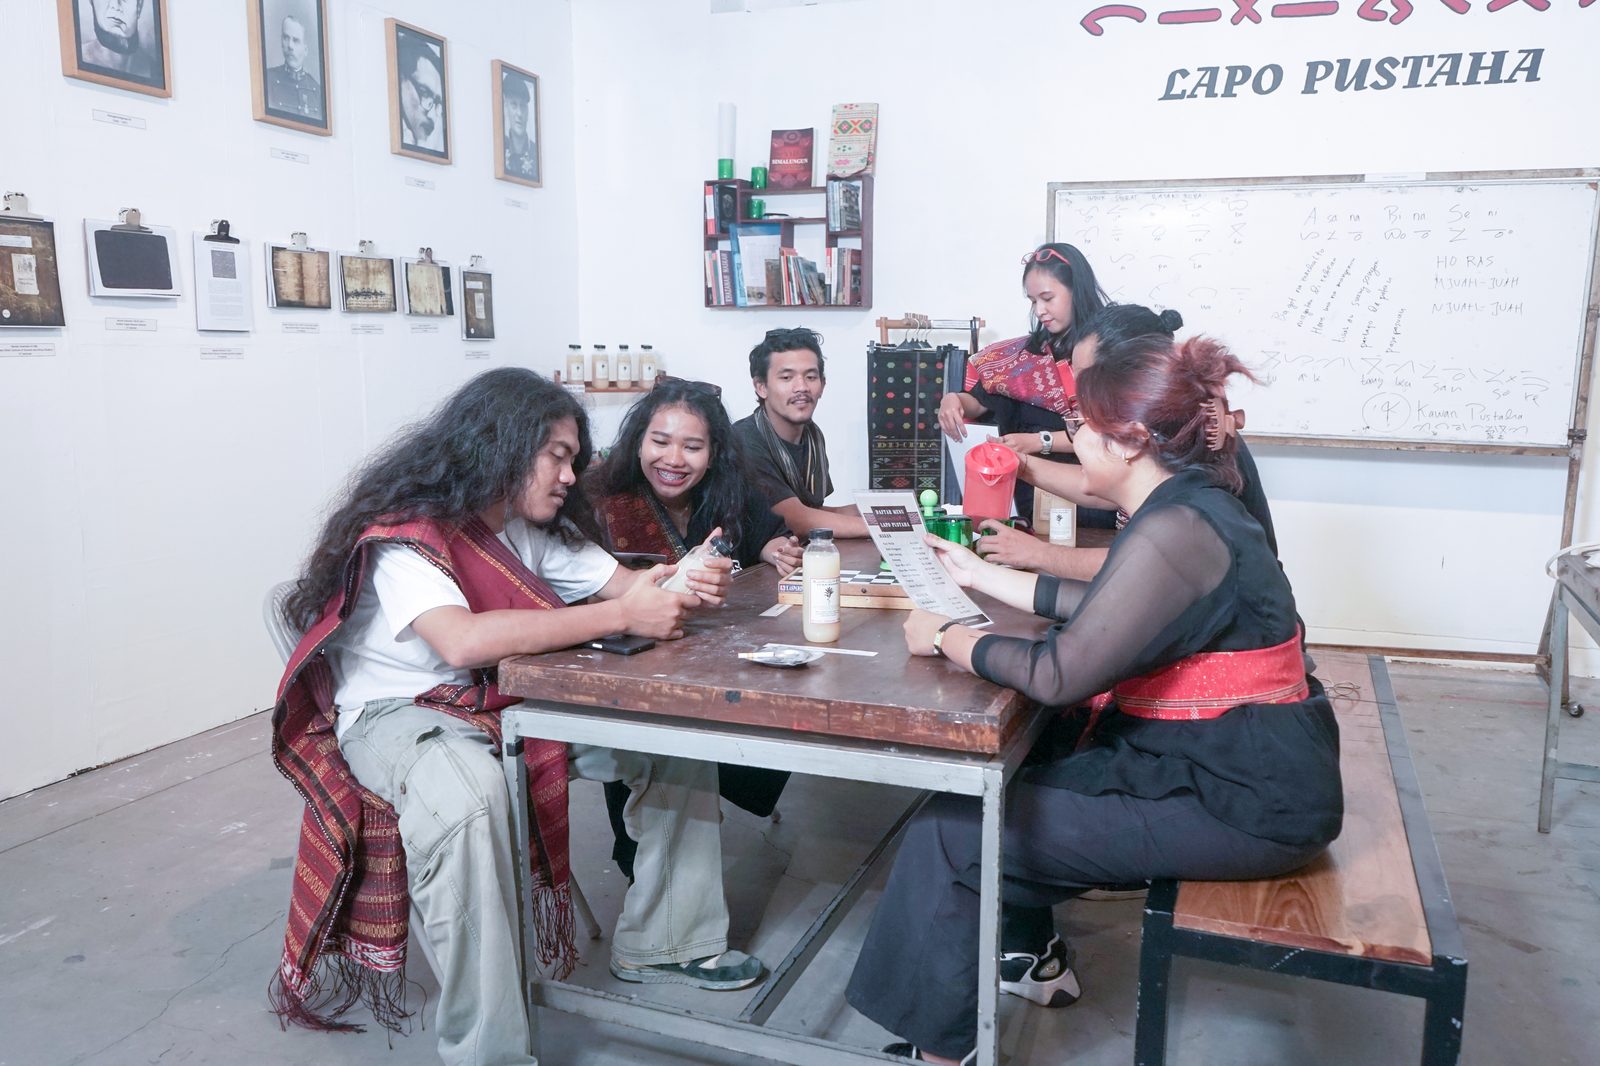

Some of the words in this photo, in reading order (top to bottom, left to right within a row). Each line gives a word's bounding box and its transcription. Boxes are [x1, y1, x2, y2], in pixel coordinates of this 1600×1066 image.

[1157, 62, 1284, 102] LAPO
[1301, 47, 1545, 95] PUSTAHA
[1416, 400, 1460, 421] Kawan
